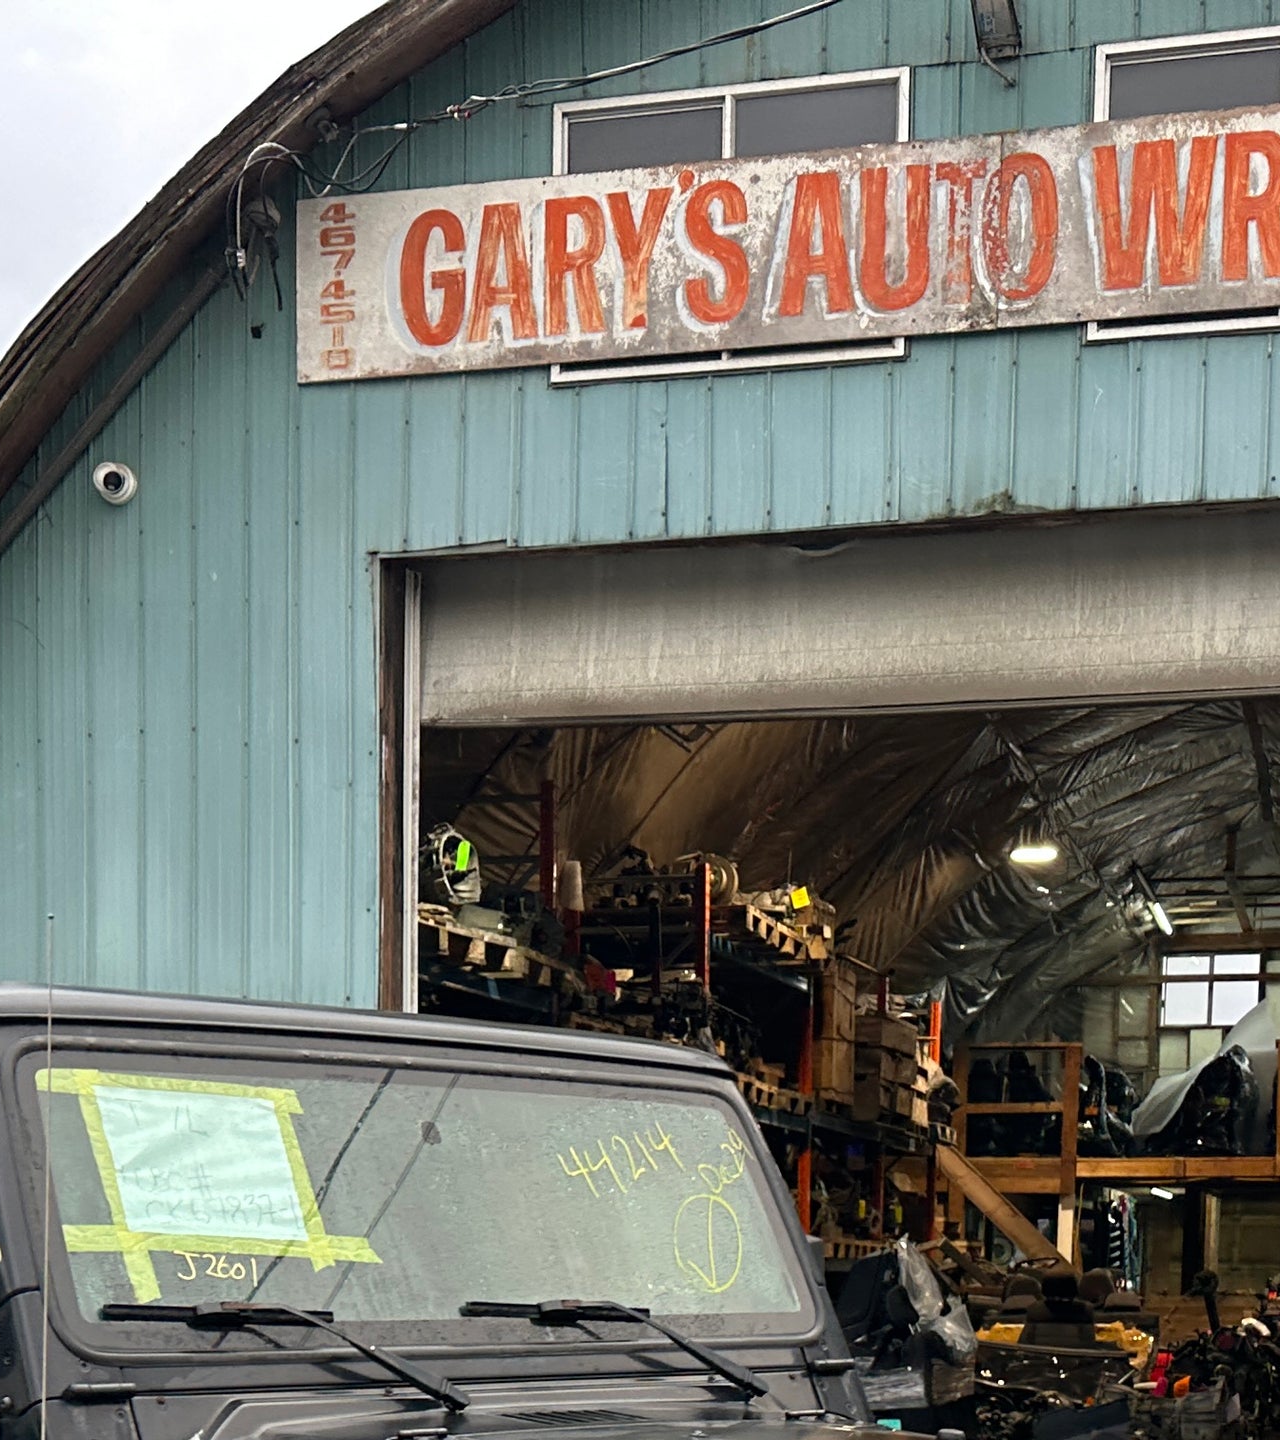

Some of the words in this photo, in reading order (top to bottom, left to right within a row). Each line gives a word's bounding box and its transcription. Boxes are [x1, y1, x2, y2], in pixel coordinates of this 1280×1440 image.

[399, 166, 749, 348] GARY'S
[778, 153, 1060, 316] AUTO
[556, 1119, 687, 1198] 44214
[173, 1249, 259, 1287] J2601
